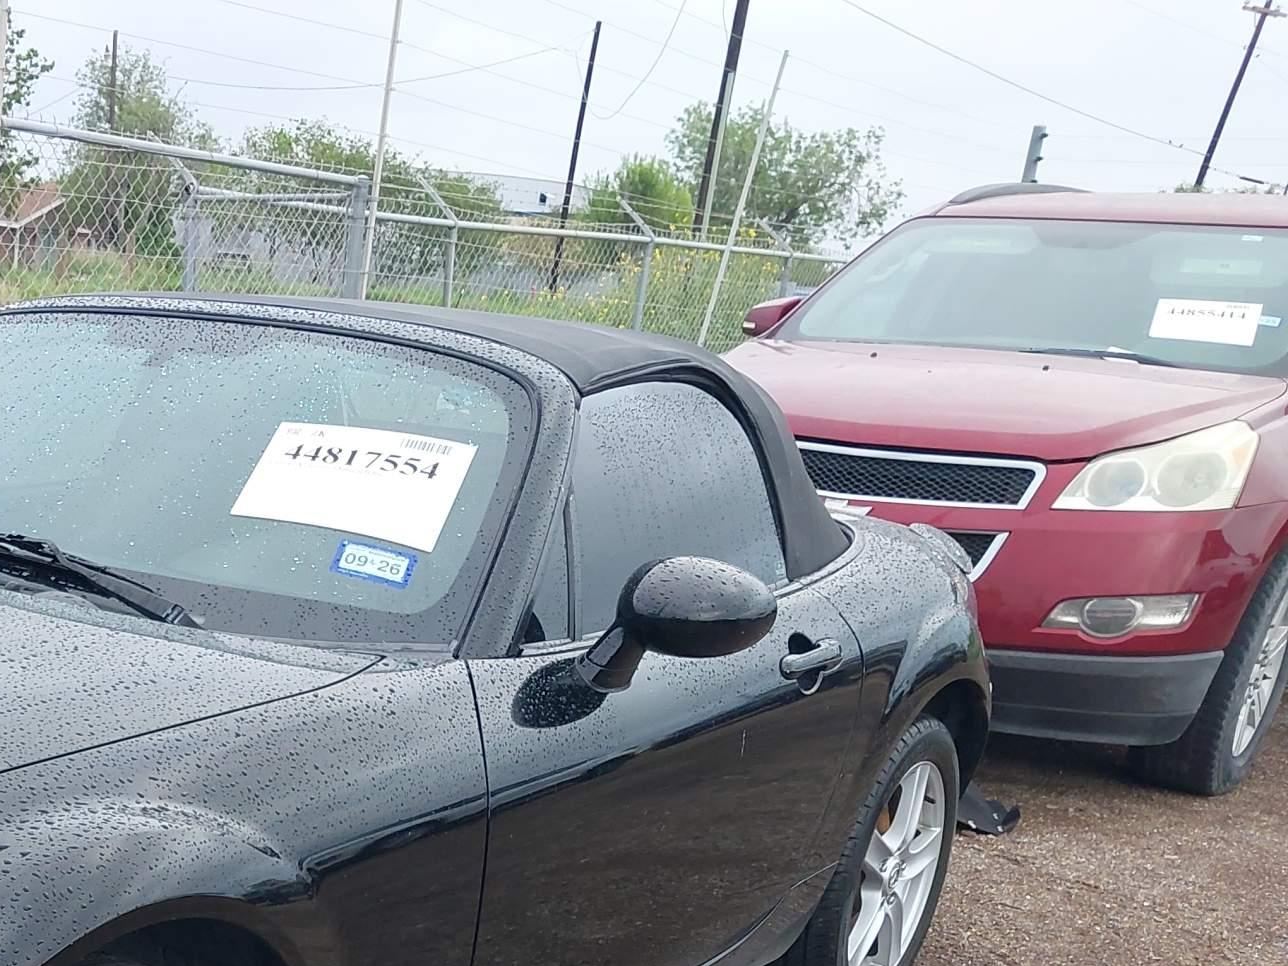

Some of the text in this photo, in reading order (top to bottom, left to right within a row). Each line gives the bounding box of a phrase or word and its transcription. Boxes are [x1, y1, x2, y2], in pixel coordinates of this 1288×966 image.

[284, 443, 440, 479] 44817554
[344, 552, 368, 567] 09
[376, 559, 402, 576] 26
